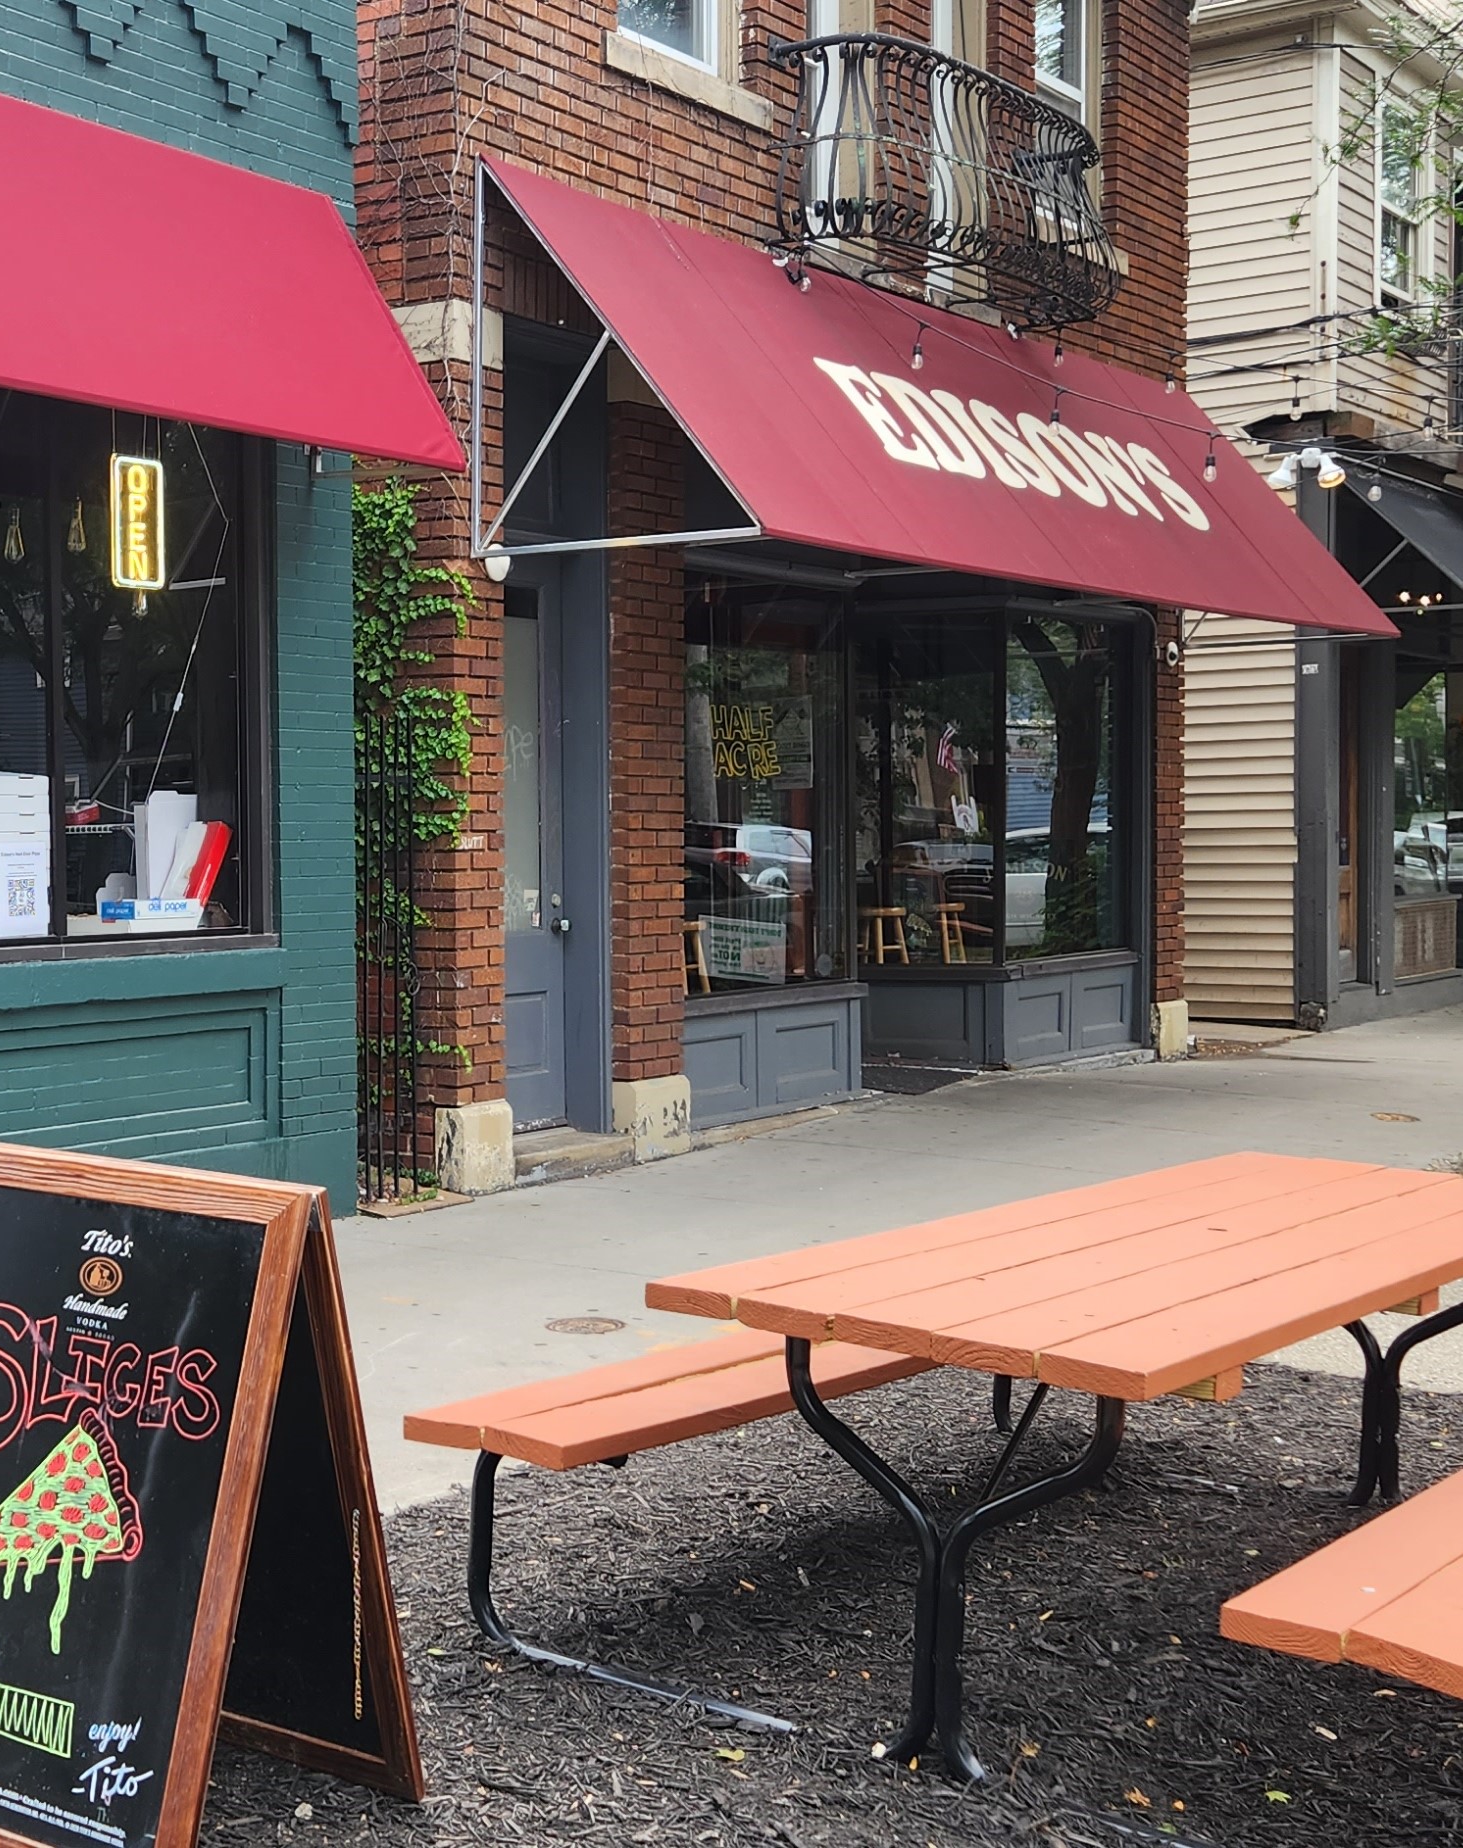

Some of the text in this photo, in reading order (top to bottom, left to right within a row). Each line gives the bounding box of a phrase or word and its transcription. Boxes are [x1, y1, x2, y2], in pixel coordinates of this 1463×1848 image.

[813, 356, 1211, 532] EDISON'S
[127, 463, 148, 581] OPEN
[710, 704, 774, 741] HALF
[714, 741, 782, 779] ACRE
[164, 902, 188, 913] paper
[81, 1229, 134, 1258] Tito's
[62, 1293, 129, 1320] Handmade
[76, 1317, 108, 1331] VODKA
[88, 1715, 143, 1753] enjoy!
